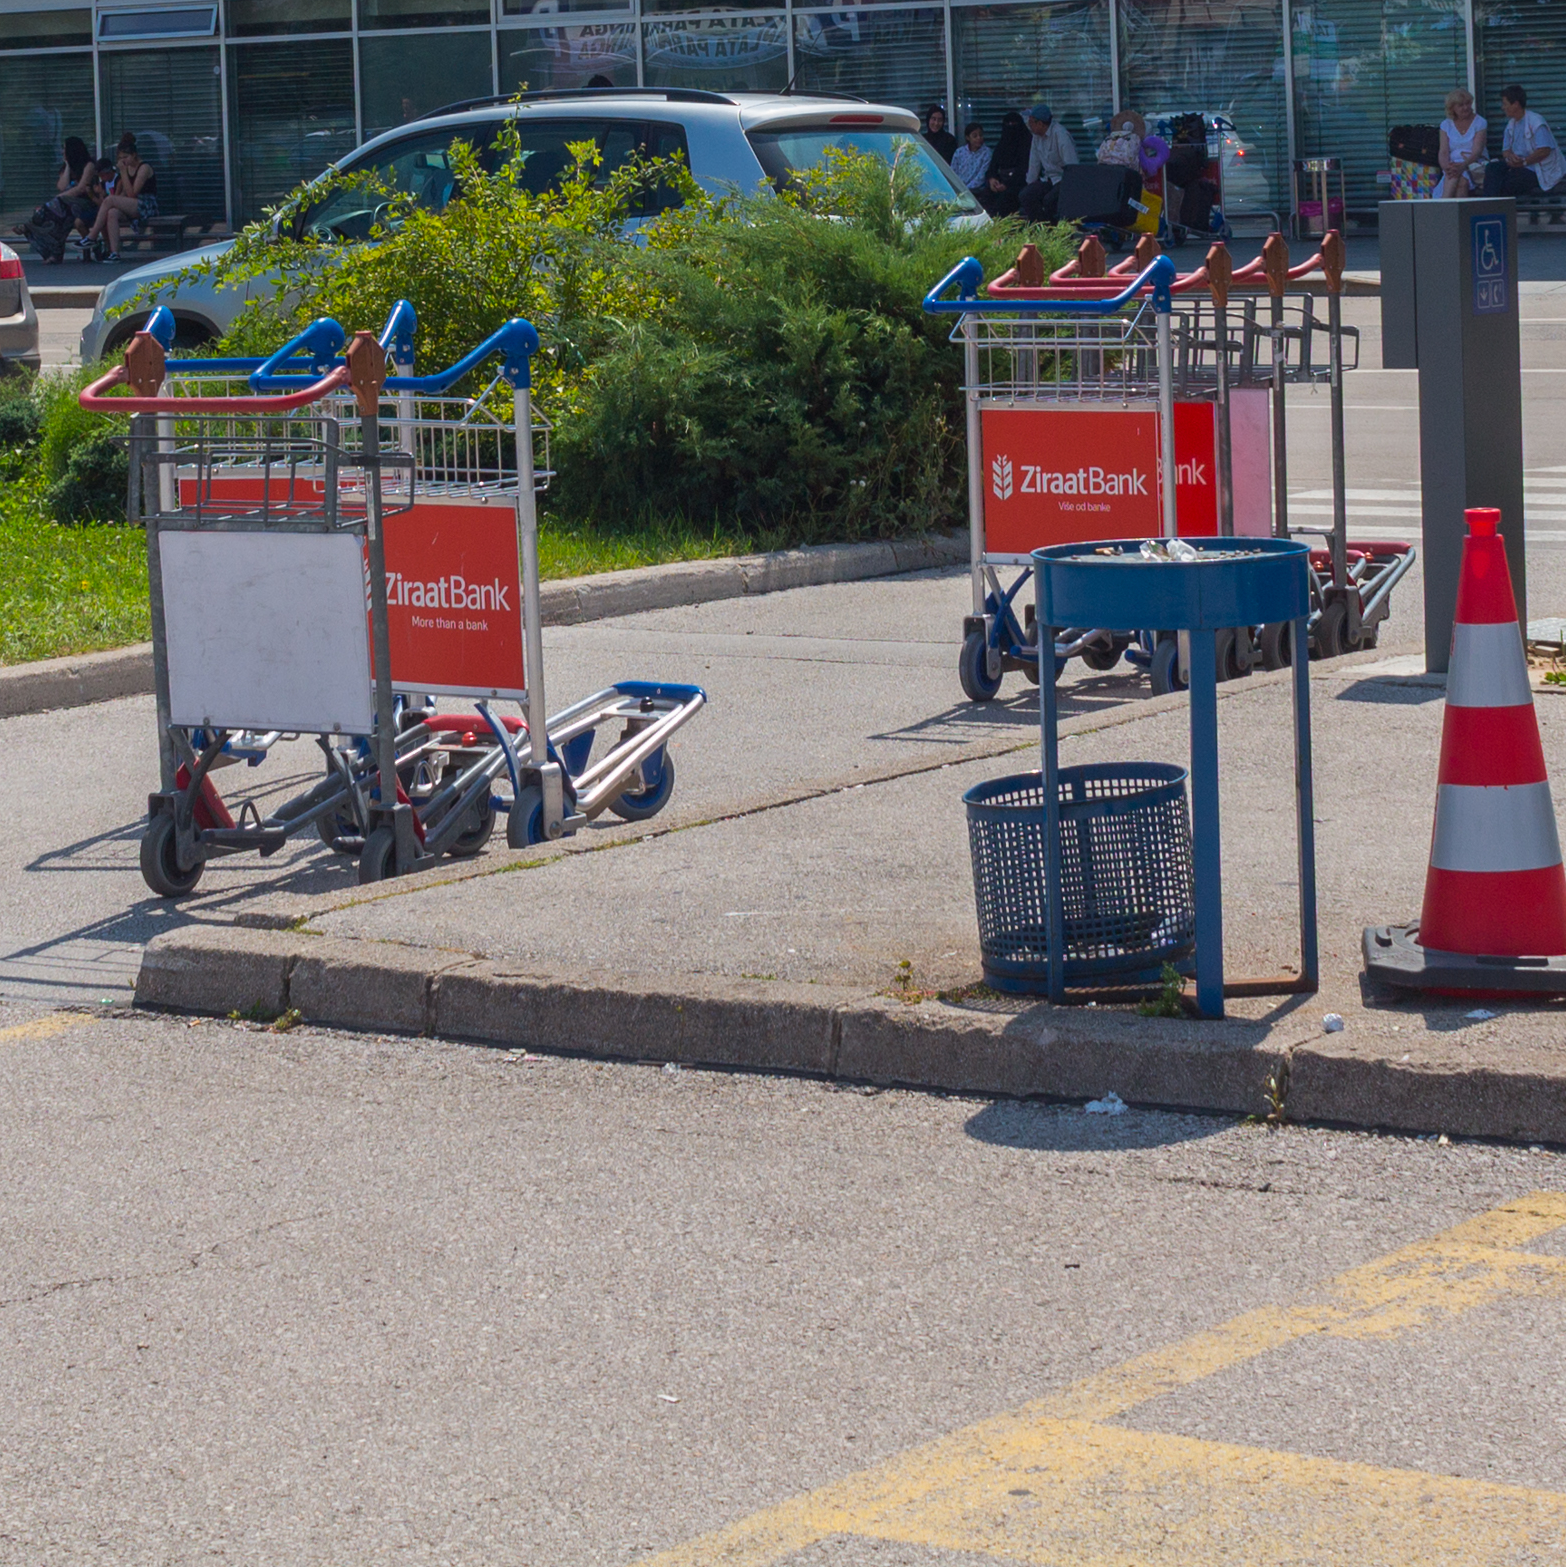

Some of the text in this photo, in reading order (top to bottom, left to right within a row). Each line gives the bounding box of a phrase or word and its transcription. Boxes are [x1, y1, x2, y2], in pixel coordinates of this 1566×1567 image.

[1020, 465, 1148, 496] ZiraatBank
[1058, 500, 1111, 512] Više od banke
[385, 572, 511, 611] ZiraatBank
[411, 615, 489, 631] More than a bank
